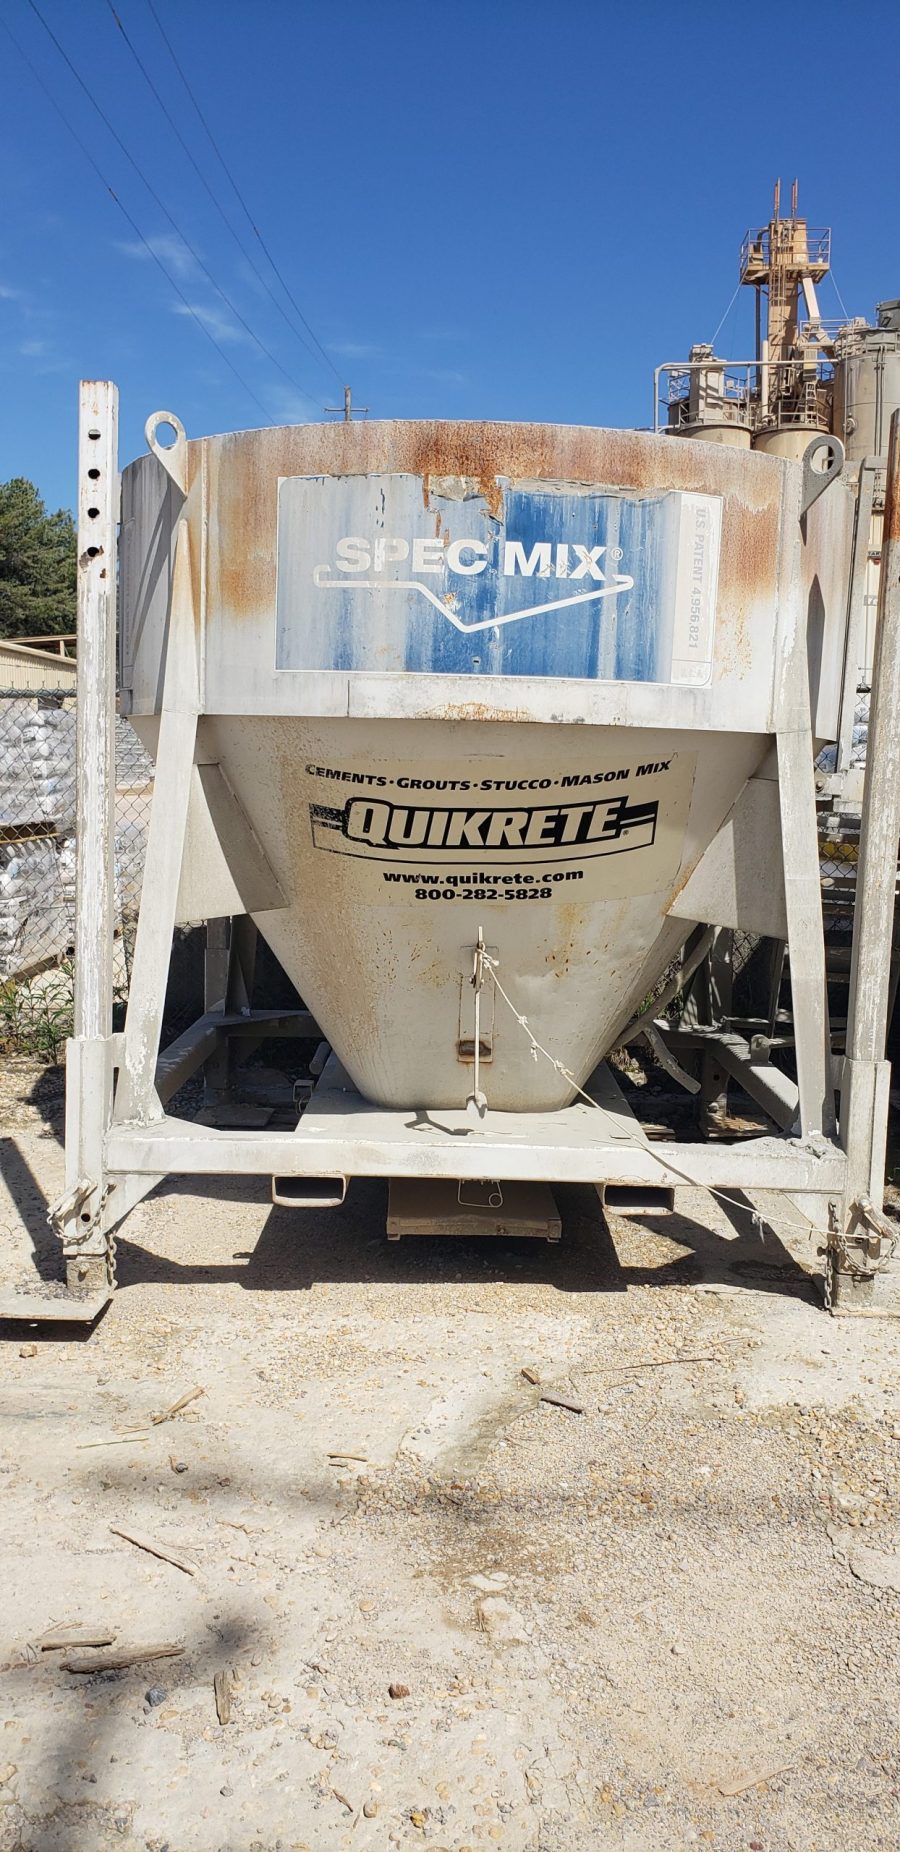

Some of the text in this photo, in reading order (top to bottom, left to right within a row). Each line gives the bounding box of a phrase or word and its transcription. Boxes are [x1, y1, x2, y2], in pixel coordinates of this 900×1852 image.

[335, 538, 488, 576] SPEC
[692, 533, 705, 583] PATENT
[688, 587, 702, 649] 4,956,821
[635, 760, 672, 776] MIX
[347, 800, 622, 846] QUIKRETE
[383, 871, 584, 887] www.quikrete.com
[415, 888, 553, 900] 800-282-5828
